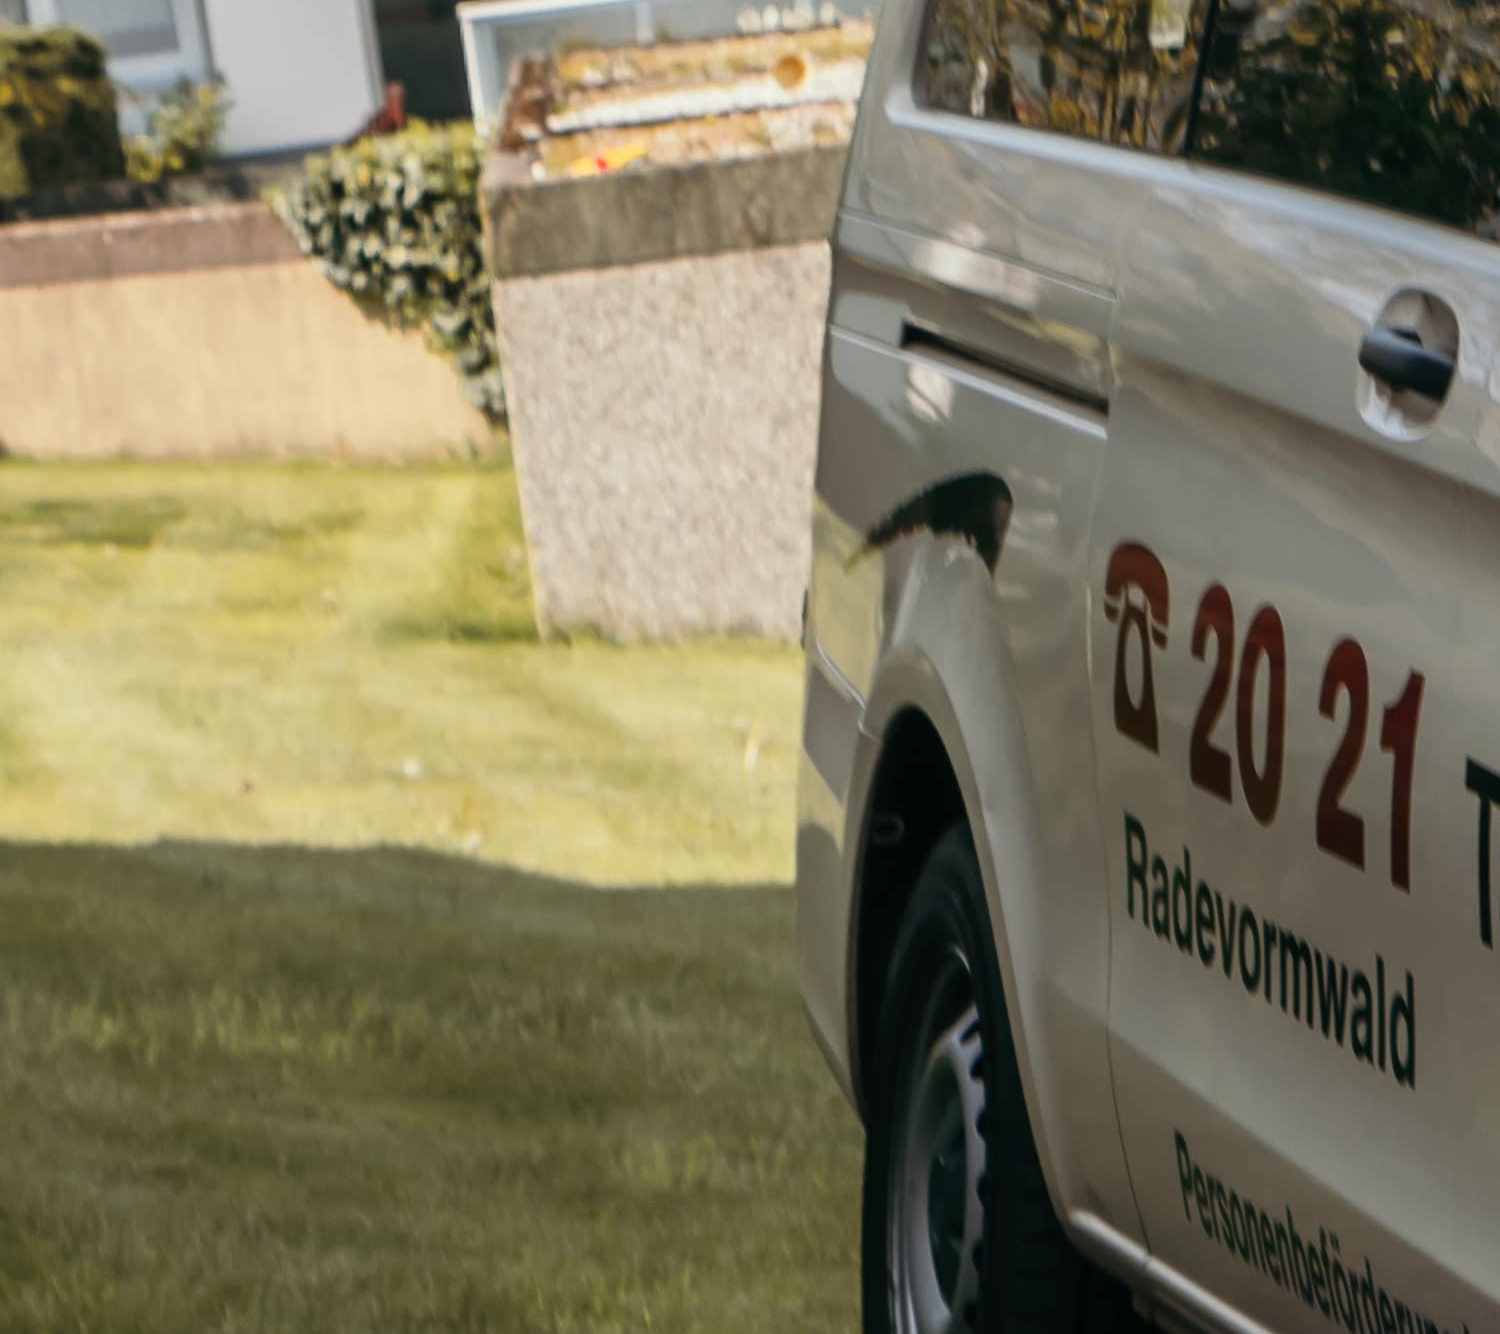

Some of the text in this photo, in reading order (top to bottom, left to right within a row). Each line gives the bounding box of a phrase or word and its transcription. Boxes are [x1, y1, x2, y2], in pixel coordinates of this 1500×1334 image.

[1189, 581, 1427, 896] 20 21
[1121, 809, 1418, 1092] Radevormwald
